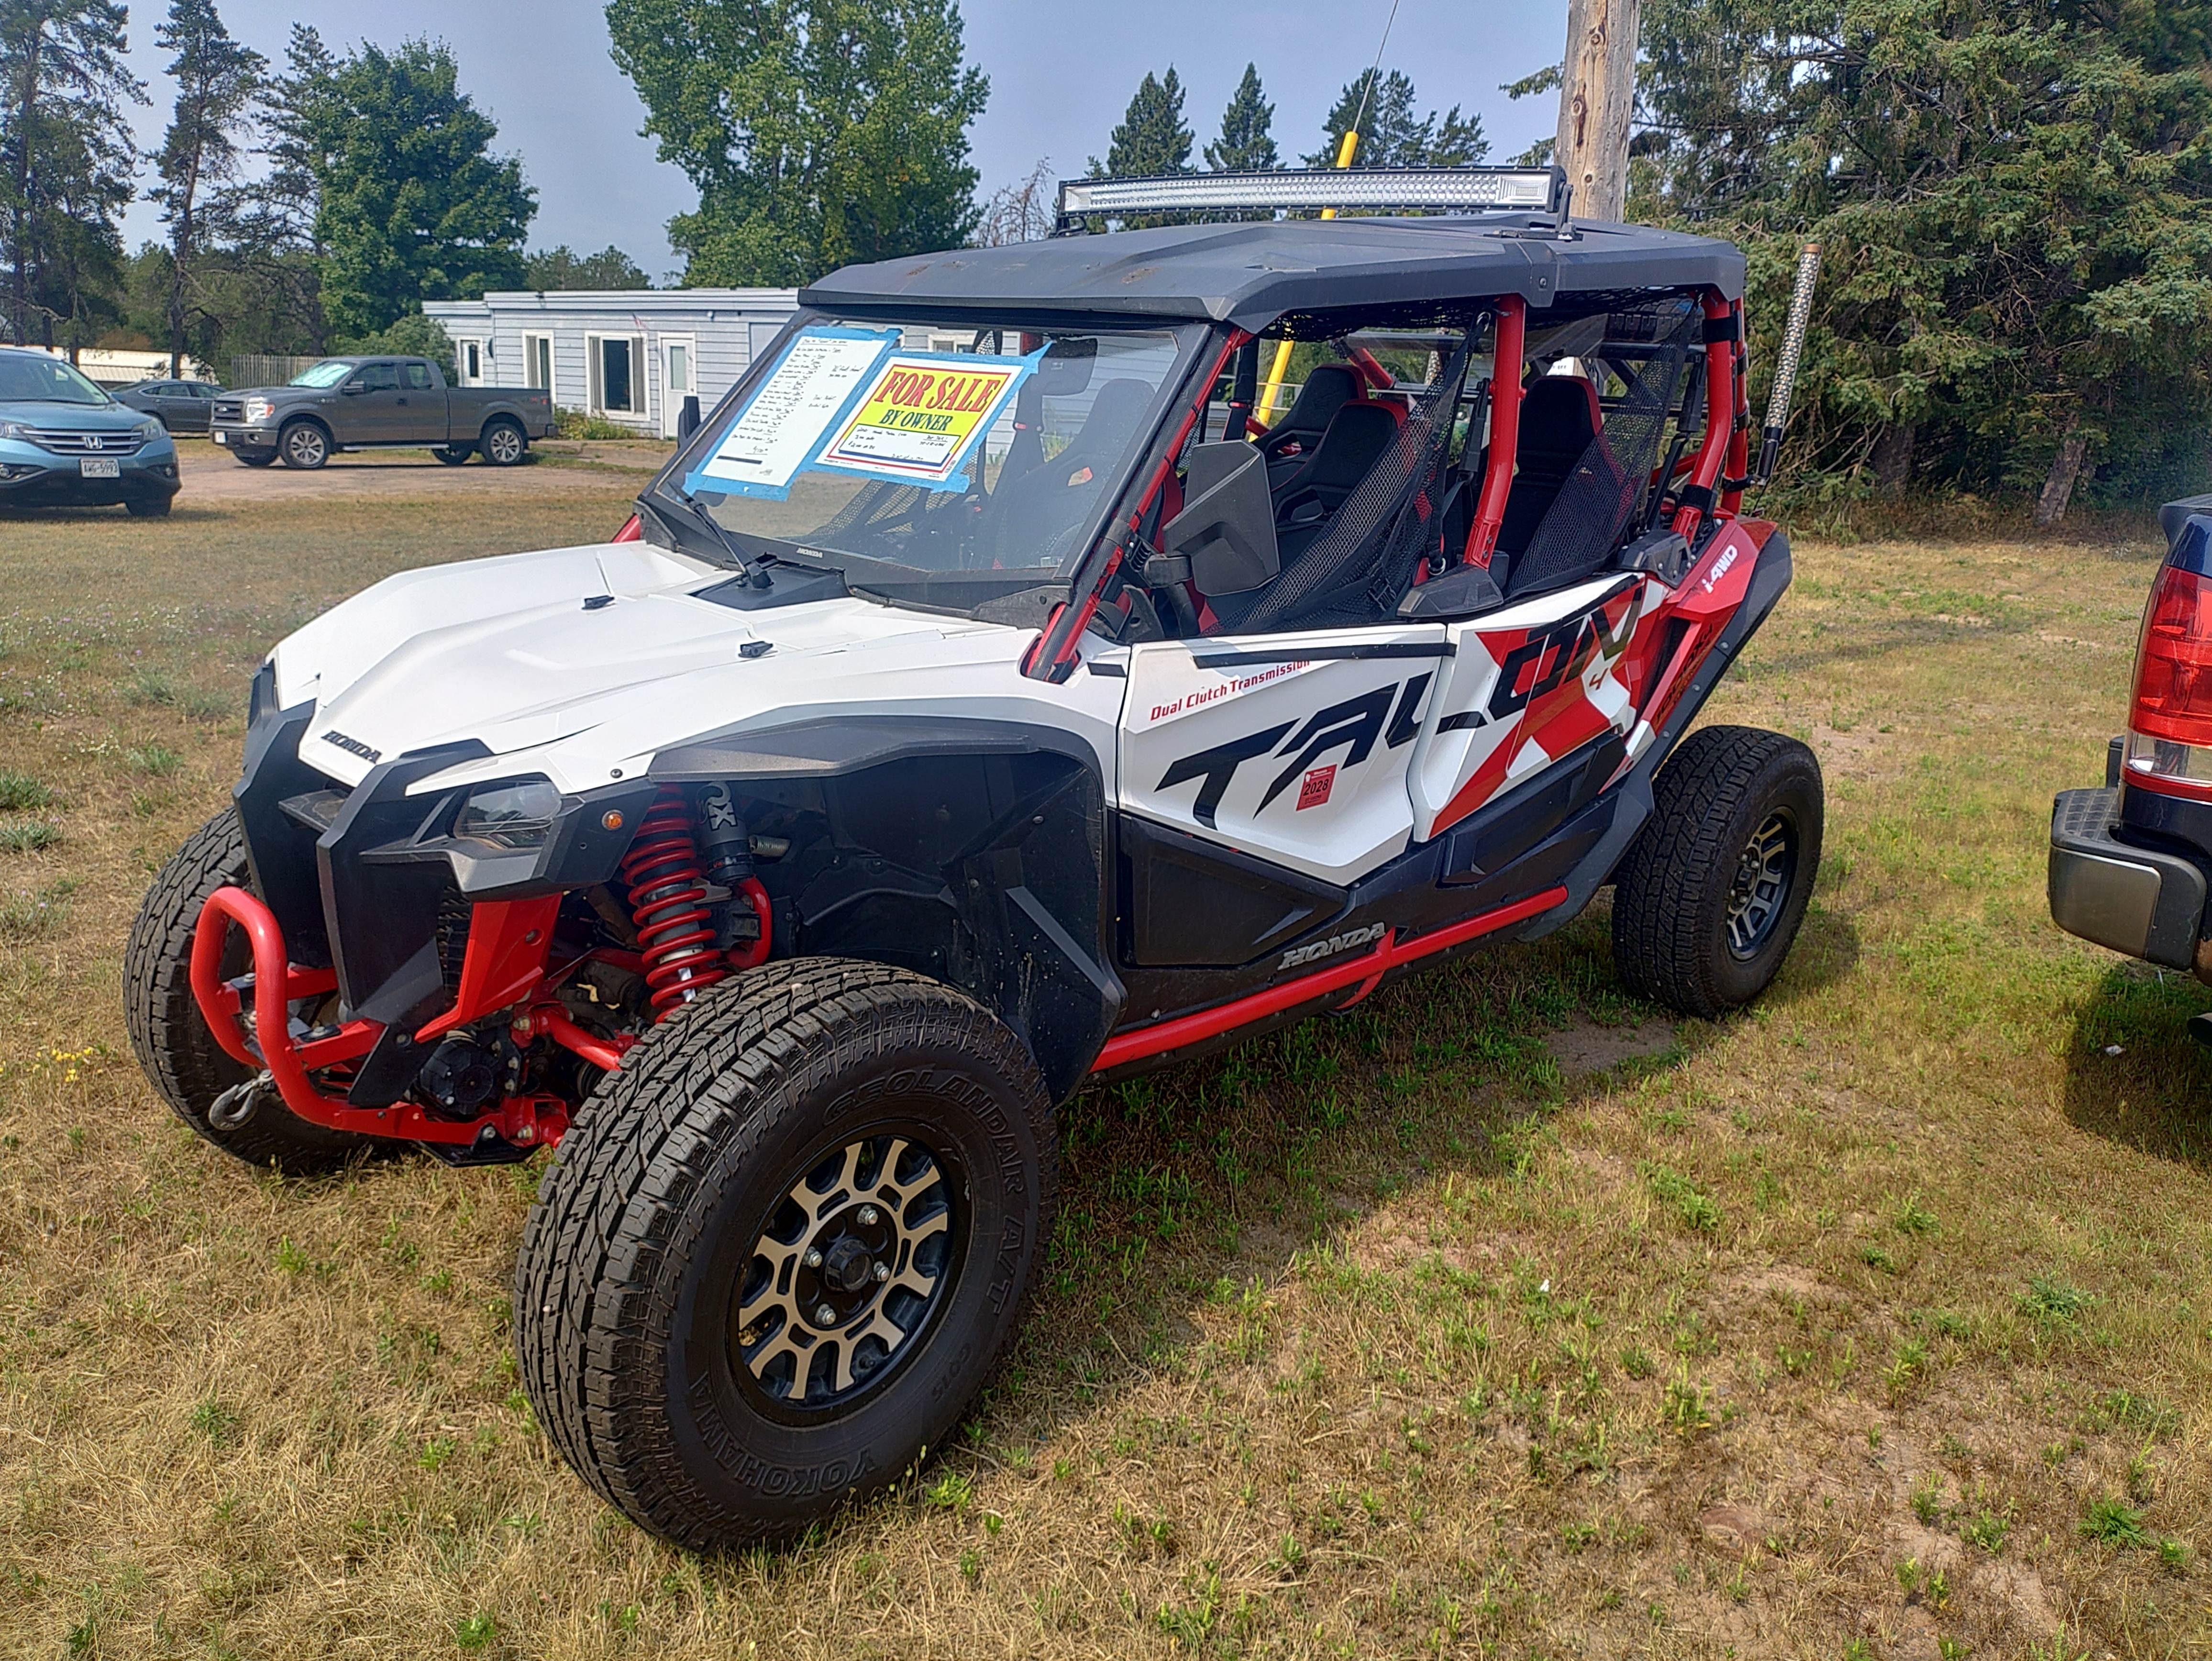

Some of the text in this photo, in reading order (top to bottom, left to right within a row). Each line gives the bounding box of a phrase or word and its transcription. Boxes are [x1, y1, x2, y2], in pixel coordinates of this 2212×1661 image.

[874, 371, 1001, 412] FOR SALE
[879, 409, 953, 431] BY OWNER
[796, 547, 823, 558] HONDA
[1150, 660, 1310, 721] Dual Clutch Transmission
[1154, 584, 1644, 830] TALON
[1589, 667, 1609, 691] 4
[321, 730, 382, 764] HONDA
[1303, 778, 1329, 796] 2028
[1277, 922, 1386, 971] HONDA
[824, 1069, 1024, 1195] GEOLANDAR
[689, 1371, 876, 1495] YOKOHAMA
